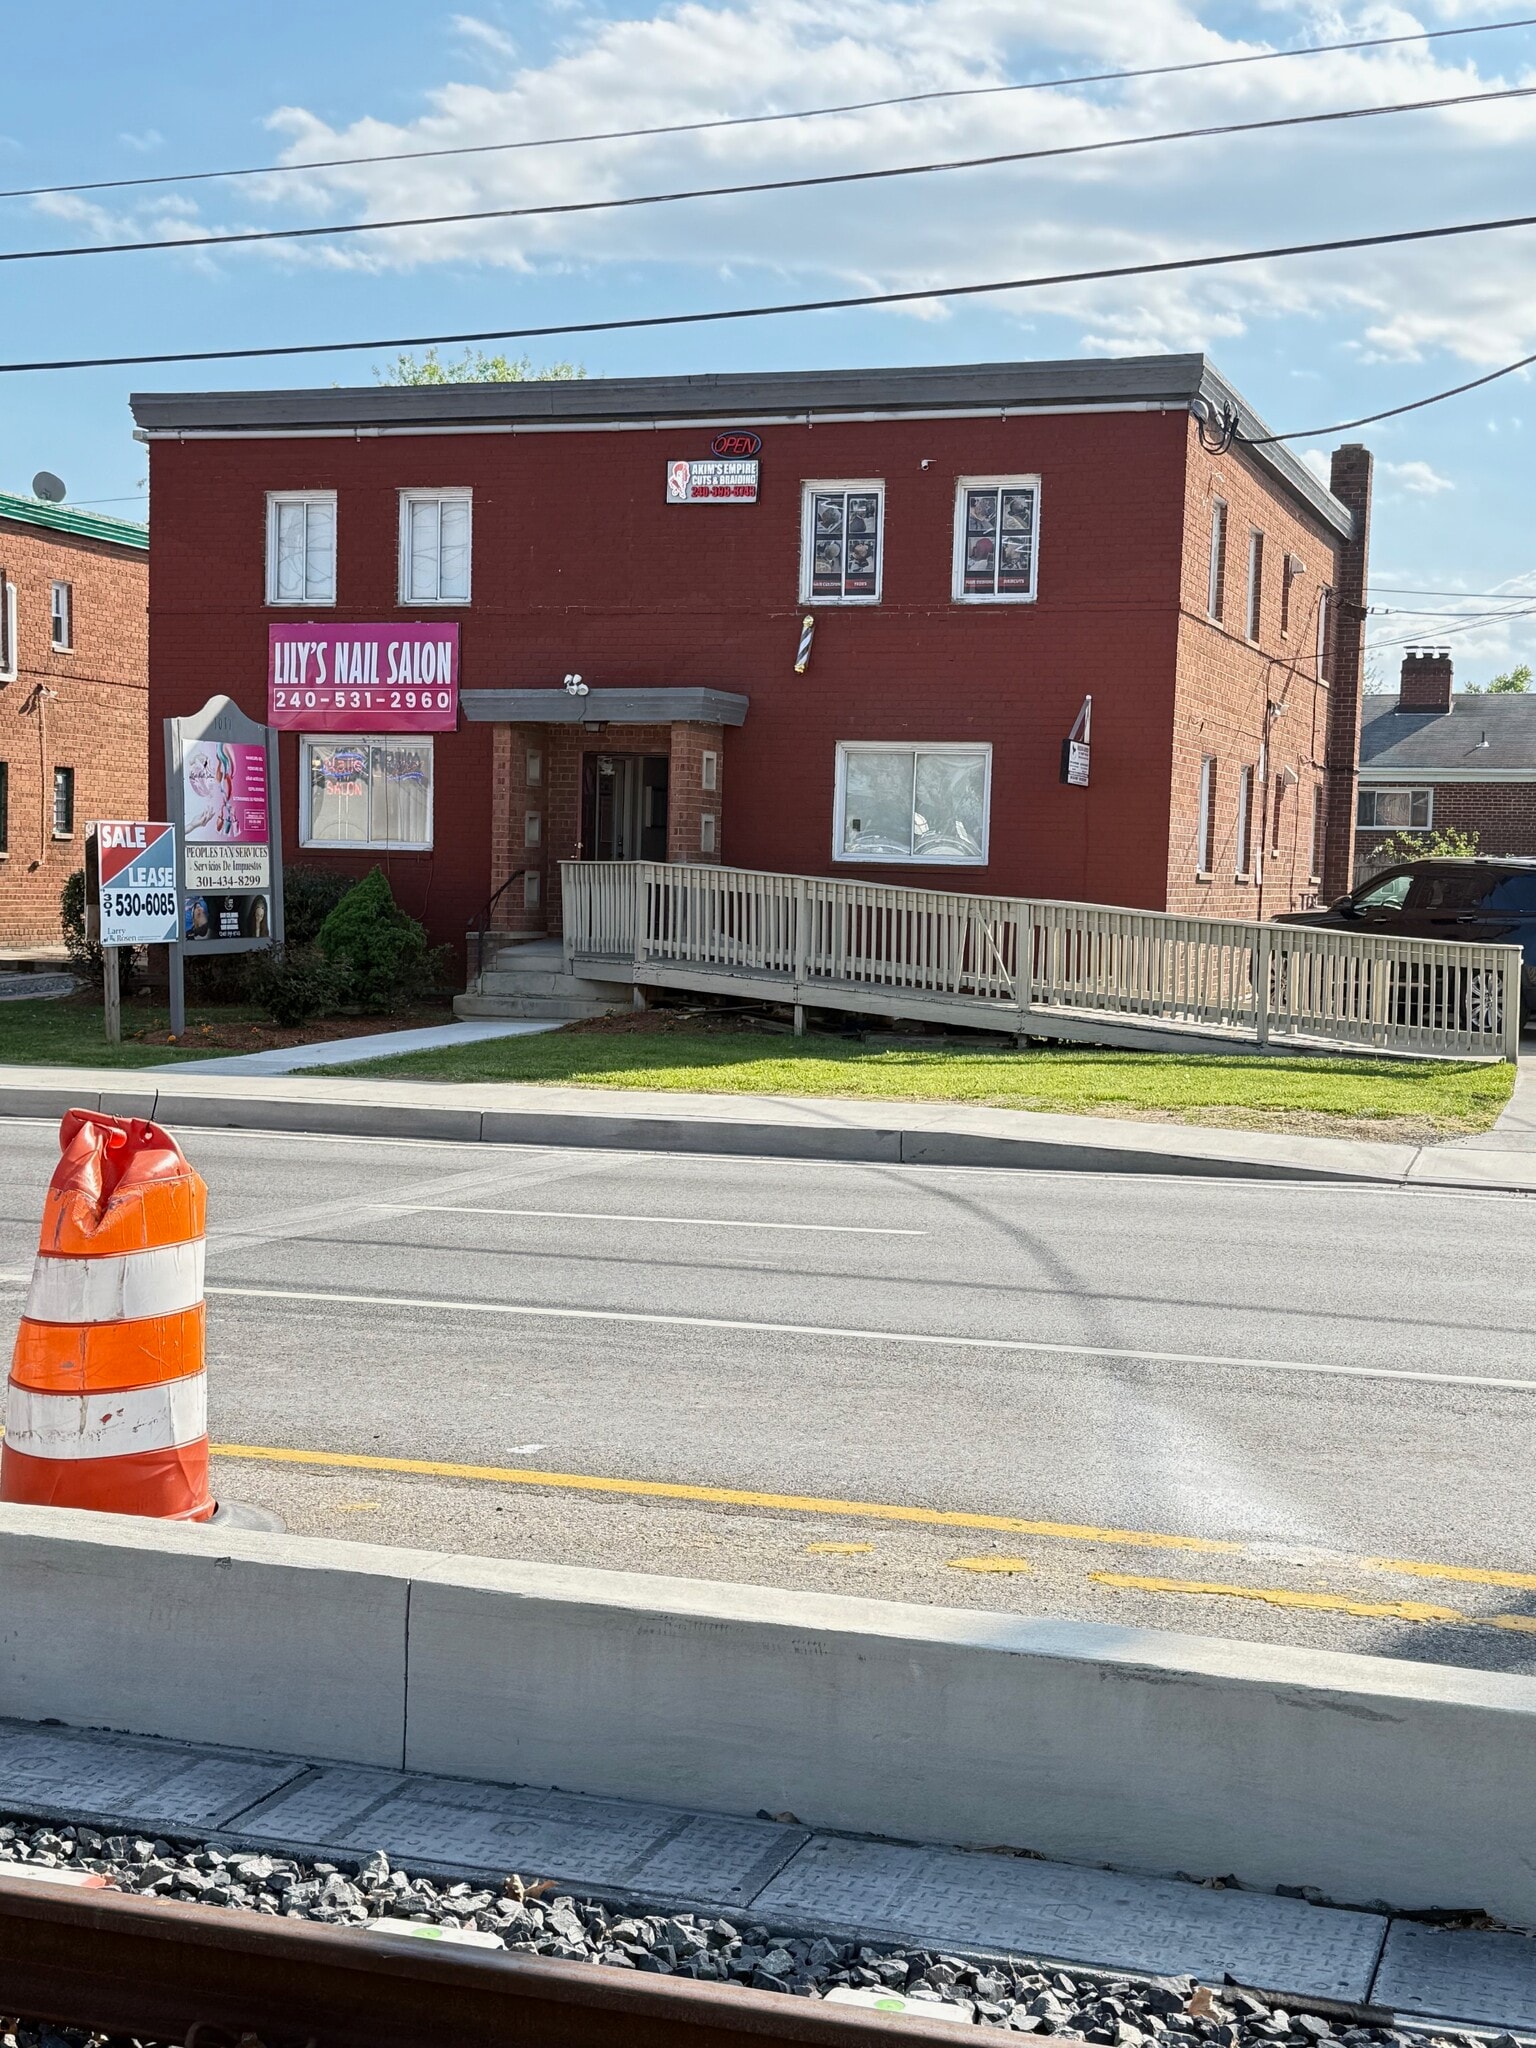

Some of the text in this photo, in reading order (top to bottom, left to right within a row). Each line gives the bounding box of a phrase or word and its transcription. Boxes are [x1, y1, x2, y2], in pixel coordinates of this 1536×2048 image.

[715, 436, 757, 453] OPEN
[724, 463, 756, 475] EMPIRE
[692, 475, 756, 485] CUTS & BRAIDING
[274, 641, 452, 684] LILY'S NAIL SALON
[276, 691, 449, 709] 240-531-2960
[326, 780, 362, 796] SALON
[101, 825, 147, 849] SALE
[186, 846, 218, 858] PEOPLES
[235, 846, 268, 858] SERVICES
[193, 860, 262, 874] Servicios De Impuestos
[128, 867, 173, 887] LEASE
[196, 875, 261, 887] 301-434-8299
[103, 893, 113, 917] 301
[115, 892, 175, 916] 530-6085
[107, 927, 126, 937] Larry
[116, 934, 137, 942] Rosen
